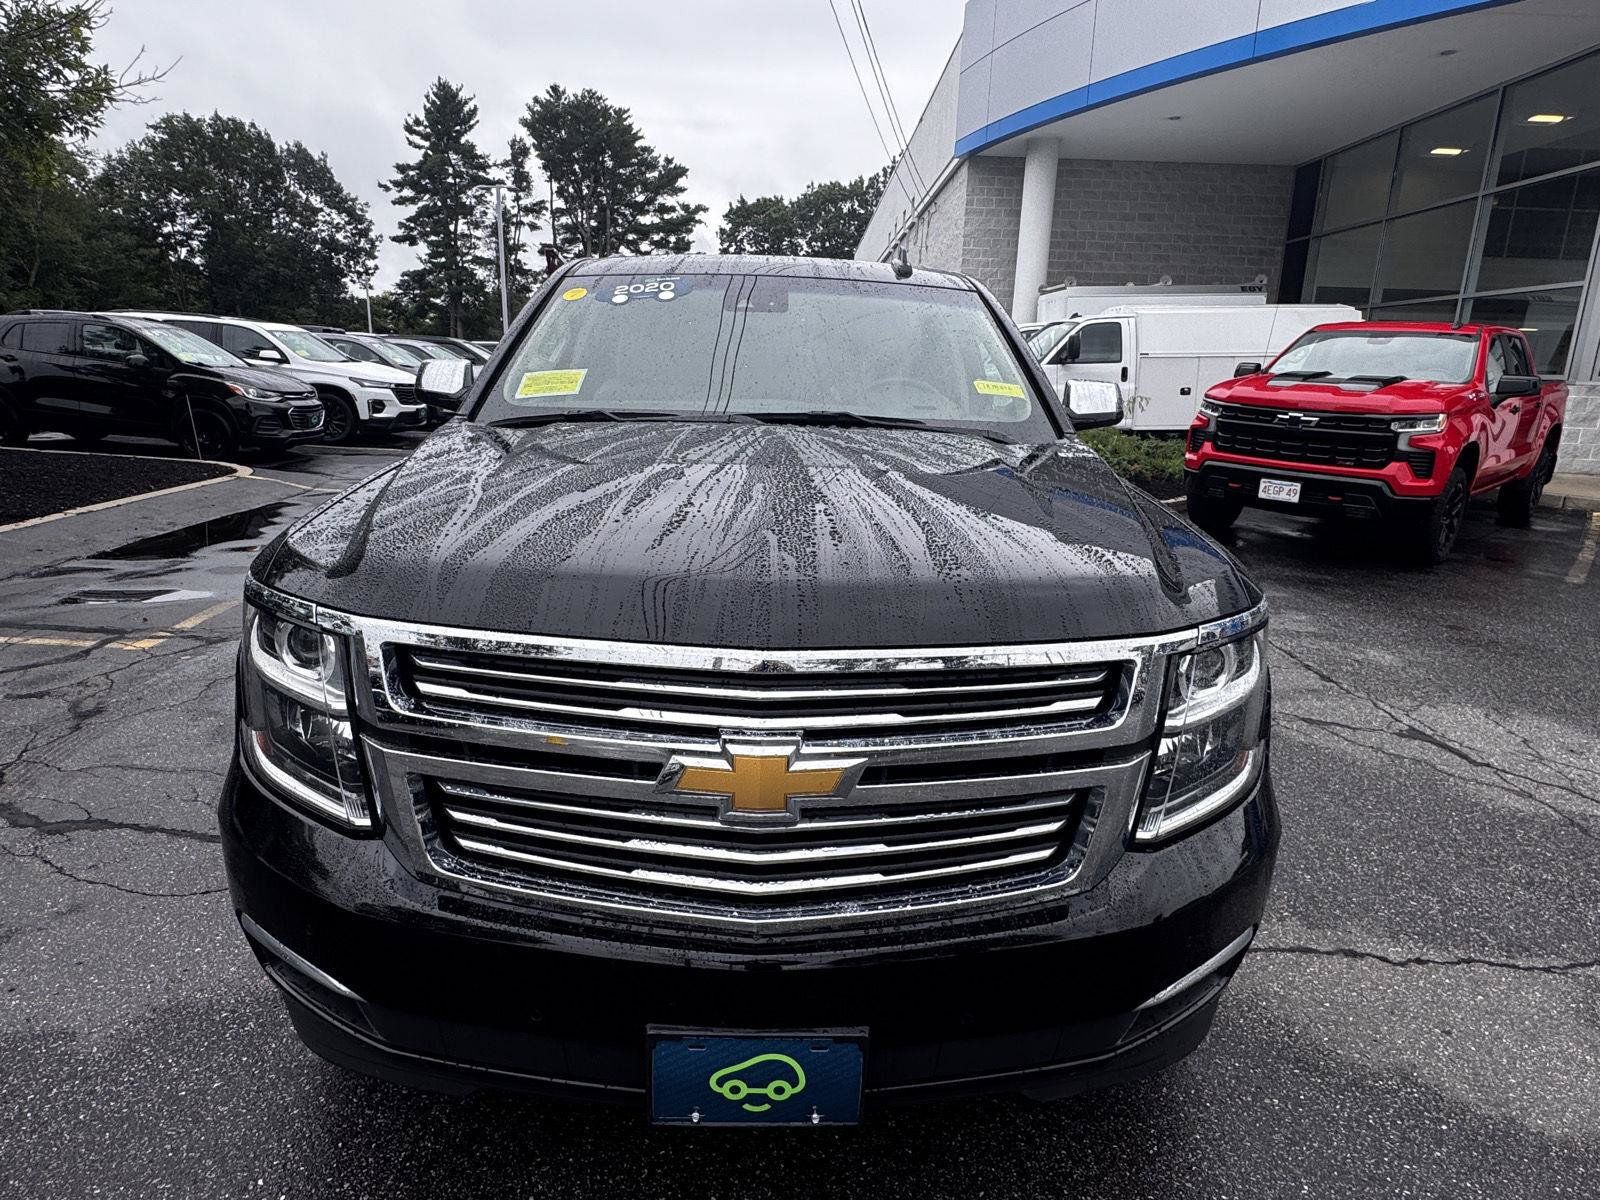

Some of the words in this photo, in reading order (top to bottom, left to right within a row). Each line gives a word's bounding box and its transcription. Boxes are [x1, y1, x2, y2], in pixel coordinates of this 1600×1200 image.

[614, 282, 675, 295] 2020
[1261, 485, 1284, 496] 4EGP
[1286, 488, 1298, 498] 49
